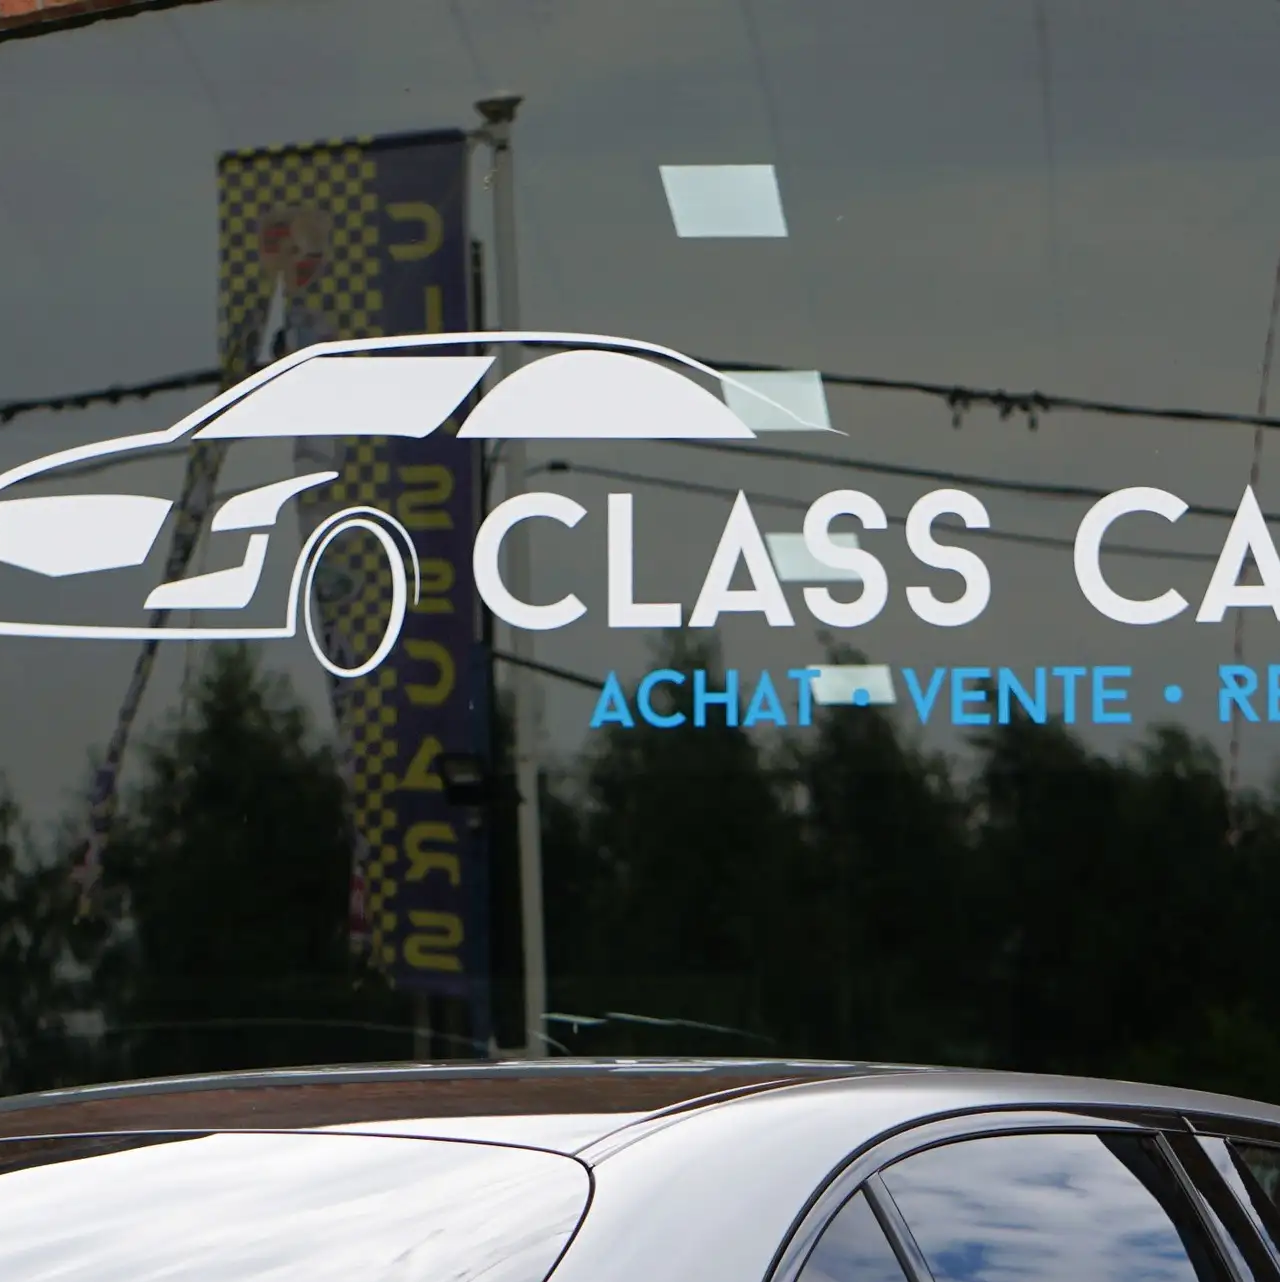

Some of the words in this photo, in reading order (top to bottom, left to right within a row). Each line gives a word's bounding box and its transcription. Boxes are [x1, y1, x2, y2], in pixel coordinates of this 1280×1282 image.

[472, 488, 992, 630] CLASS
[589, 667, 822, 729] ACHAT
[902, 665, 1133, 725] VENTE
